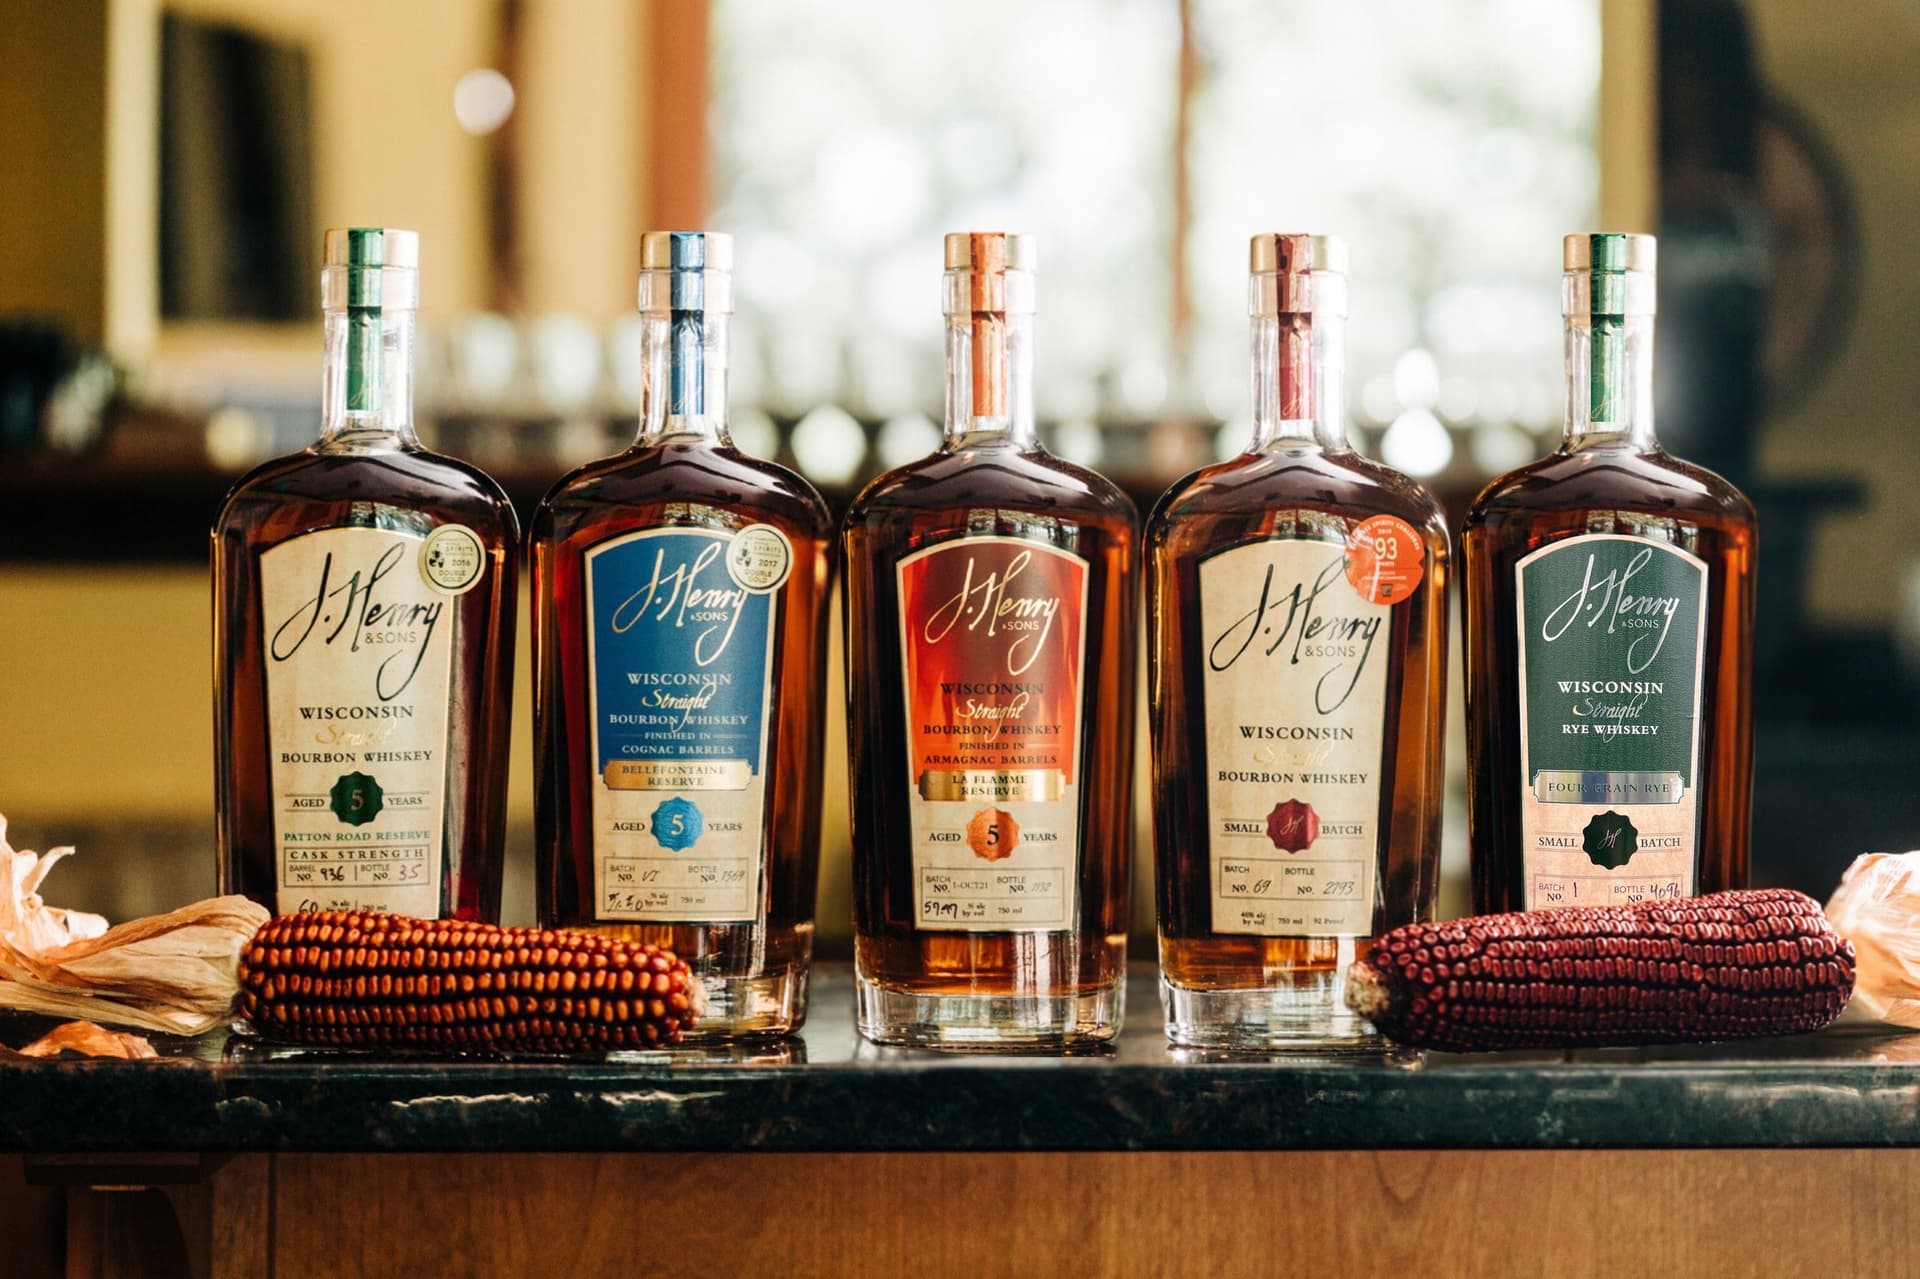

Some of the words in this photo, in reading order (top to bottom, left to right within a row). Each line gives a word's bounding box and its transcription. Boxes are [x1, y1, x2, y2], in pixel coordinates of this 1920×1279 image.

[1375, 537, 1398, 561] 93
[758, 559, 778, 568] 2017
[627, 672, 732, 686] WISCONSIN
[940, 683, 1044, 695] WISCONSIN
[1557, 681, 1665, 695] WISCONSIN
[299, 706, 414, 720] WISCONSIN
[641, 682, 717, 734] Straight
[609, 714, 679, 725] BOURBON
[685, 715, 749, 725] WHISKEY
[955, 692, 1030, 743] Straight
[1572, 693, 1649, 744] Straight
[923, 725, 992, 735] BOURBON
[999, 725, 1061, 735] WHISKEY
[1240, 726, 1354, 740] WISCONSIN
[1562, 724, 1589, 734] RYE
[1593, 725, 1659, 735] WHISKEY
[645, 732, 696, 740] FINISHED
[700, 732, 712, 740] IN
[622, 745, 675, 755] COGNAC
[679, 745, 735, 755] BARRELS
[281, 752, 356, 763] BOURBON
[363, 750, 433, 762] WHISKEY
[925, 755, 996, 765] ARMAGNAC
[1001, 755, 1057, 765] BARRELS
[622, 765, 727, 775] BELLEFONTAINE
[647, 777, 705, 786] RESERVE
[952, 775, 969, 784] LA
[974, 775, 1027, 784] FLAMME
[1218, 771, 1294, 783] BOURBON
[1299, 773, 1368, 784] WHISKEY
[961, 787, 1020, 796] RESERVE
[1548, 782, 1587, 793] FOUR
[1591, 783, 1639, 793] GRAIN
[1644, 783, 1670, 793] RYE
[292, 799, 325, 808] AGED
[350, 789, 364, 811] 5
[388, 797, 423, 806] YEARS
[612, 822, 646, 832] AGED
[670, 814, 685, 836] 5
[708, 823, 743, 832] YEARS
[1224, 823, 1263, 833] SMALL
[1322, 825, 1363, 835] BATCH
[284, 833, 331, 842] PATTON
[336, 832, 371, 841] ROAD
[376, 831, 431, 841] RESERVE
[928, 832, 961, 842] AGED
[986, 824, 1000, 846] 5
[1023, 832, 1058, 842] YEARS
[1538, 837, 1579, 848] SMALL
[1640, 837, 1681, 848] BATCH
[290, 850, 329, 860] CASK
[338, 849, 424, 860] STRENGTH
[320, 865, 345, 882] 936
[360, 864, 390, 872] BOTTLE
[398, 863, 423, 881] 35
[610, 864, 636, 872] BATCH
[688, 865, 718, 873] BOTTLE
[1224, 865, 1250, 873] BATCH
[1284, 867, 1316, 876] BOTTLE
[926, 875, 951, 883] BATCH
[996, 876, 1026, 884] BOTTLE
[1253, 879, 1272, 894] 69
[1538, 883, 1565, 891] BATCH
[1614, 885, 1645, 893] BOTTLE
[1278, 917, 1290, 925] 750
